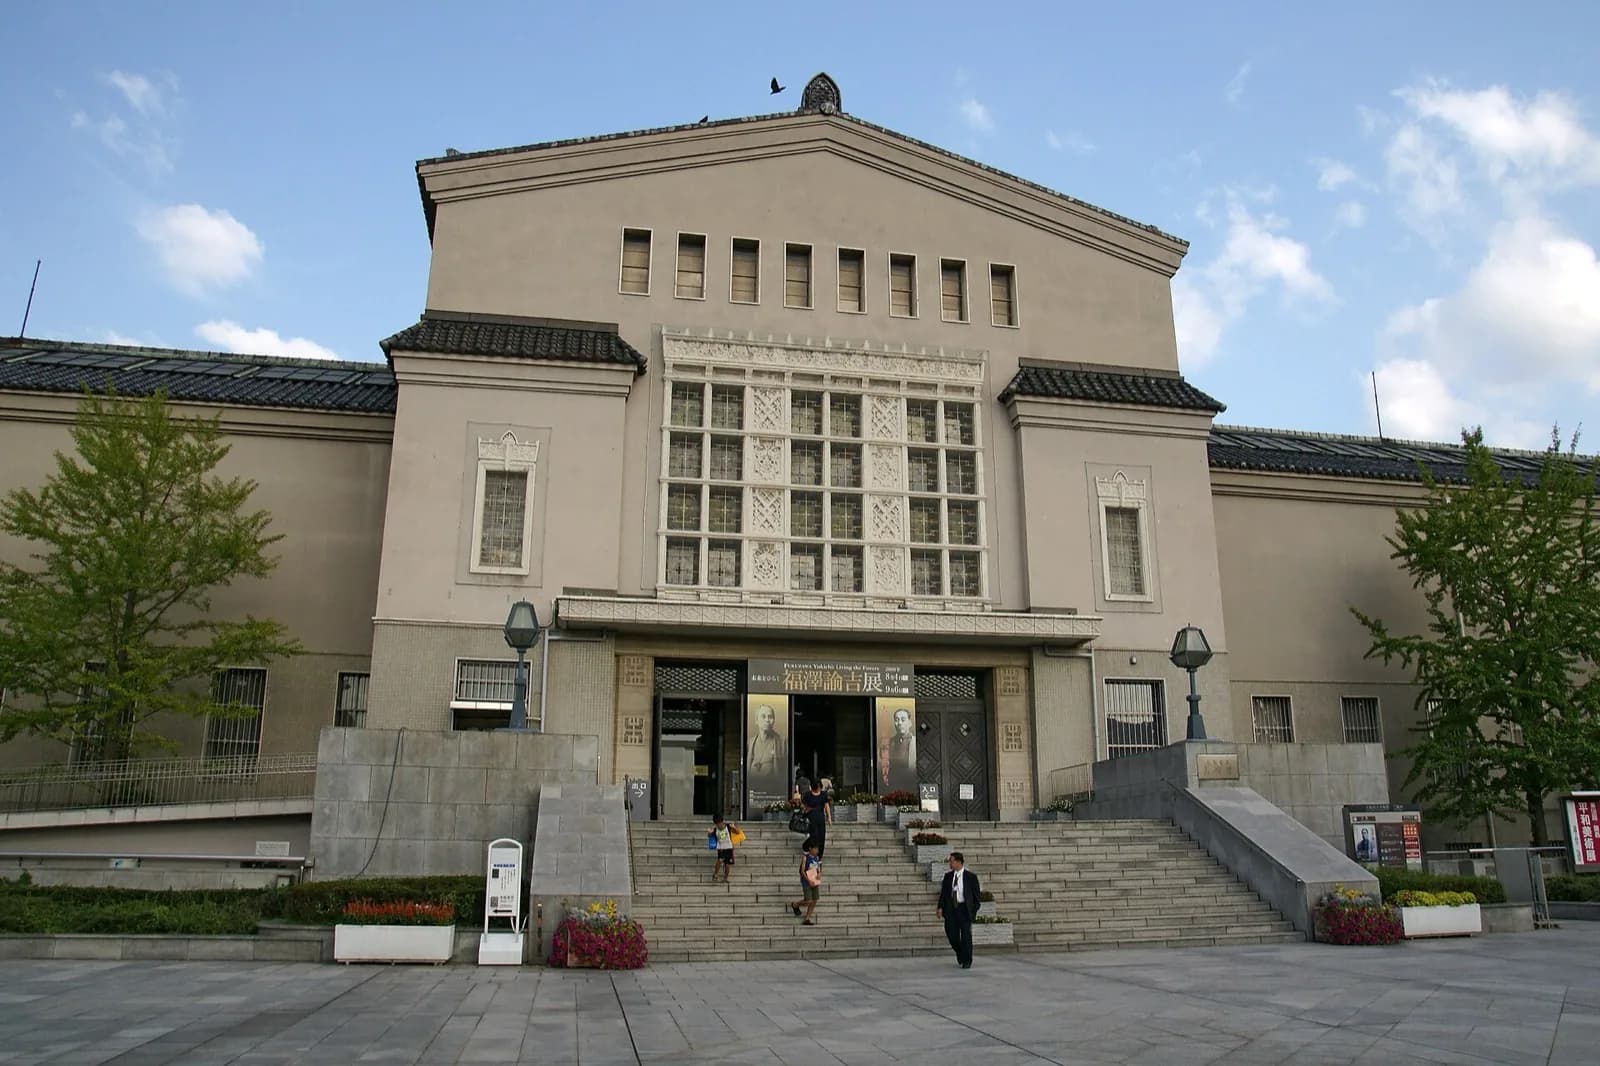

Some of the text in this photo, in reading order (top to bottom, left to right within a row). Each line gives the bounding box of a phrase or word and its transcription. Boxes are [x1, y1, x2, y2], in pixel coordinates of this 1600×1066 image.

[1578, 801, 1596, 861] 平和美術展
